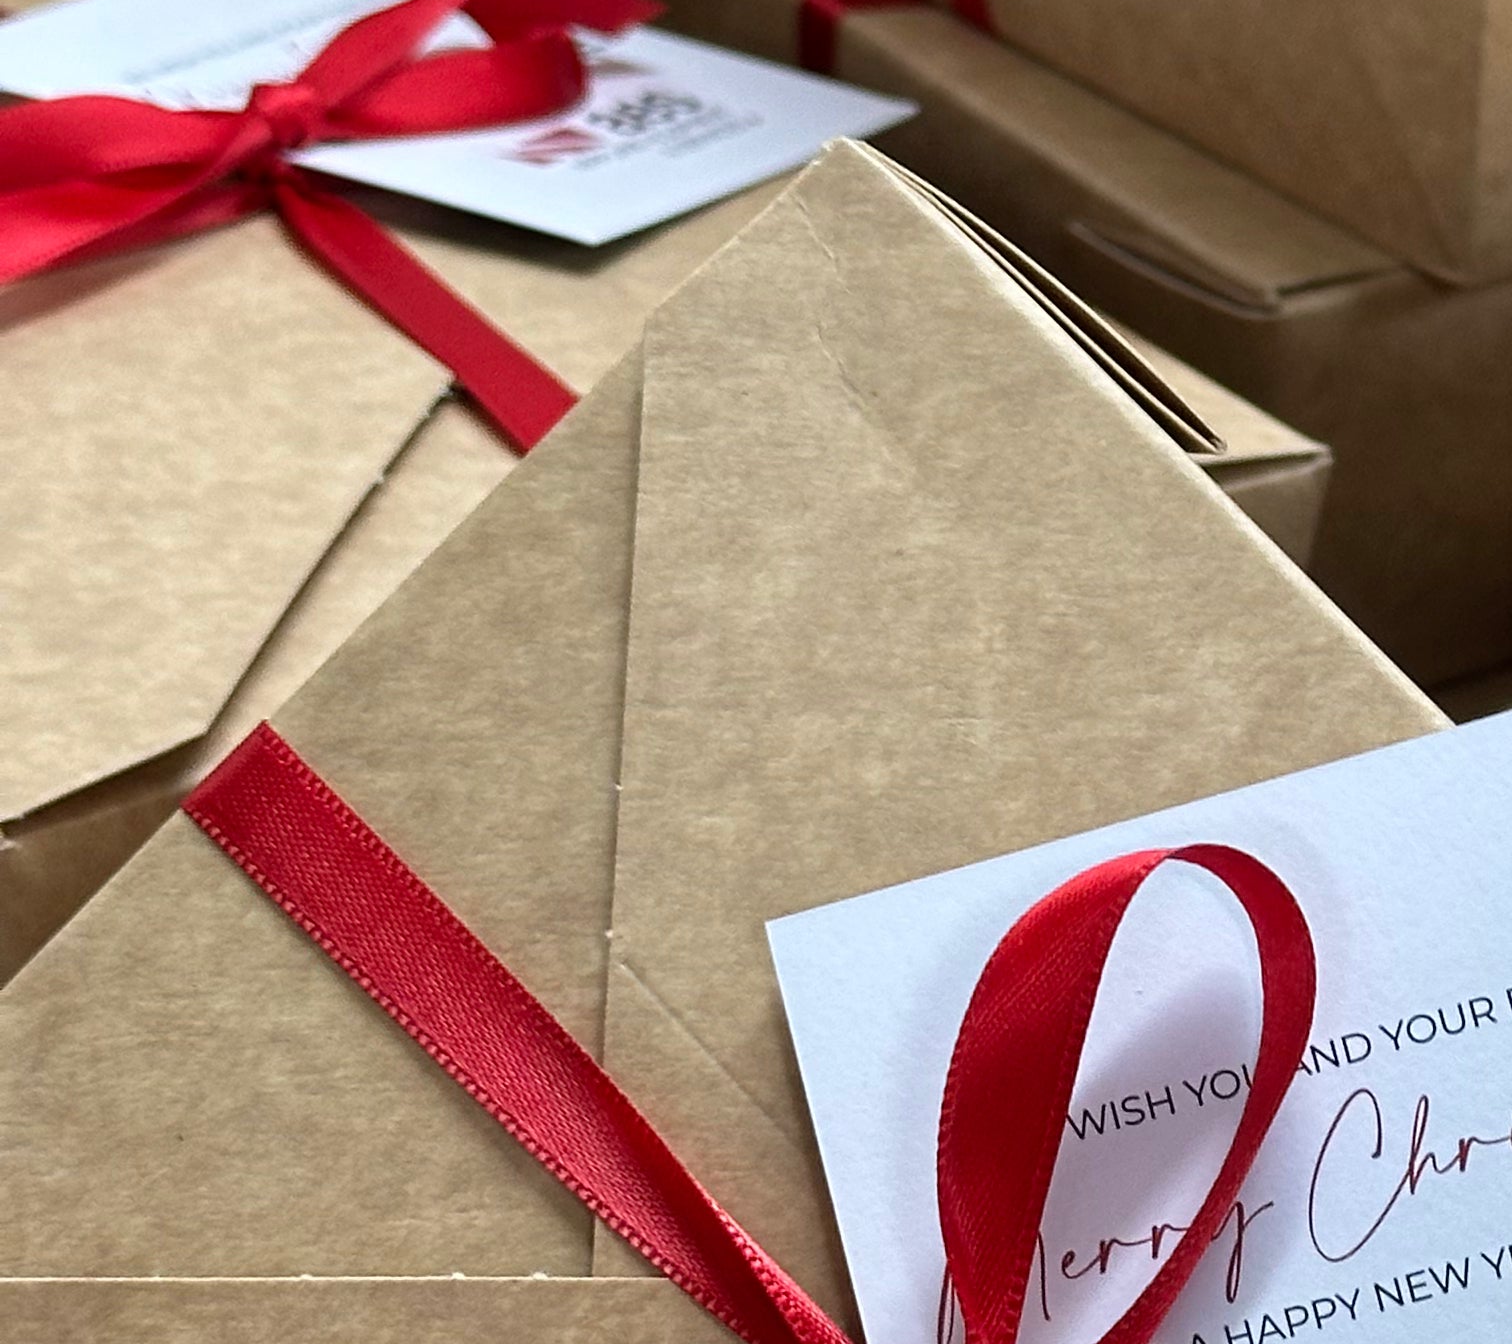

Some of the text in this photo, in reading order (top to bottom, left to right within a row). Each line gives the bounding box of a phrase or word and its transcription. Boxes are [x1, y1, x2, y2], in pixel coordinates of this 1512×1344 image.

[1065, 1085, 1176, 1141] WISH
[1378, 996, 1498, 1053] YOUR
[1374, 1256, 1471, 1313] NEW
